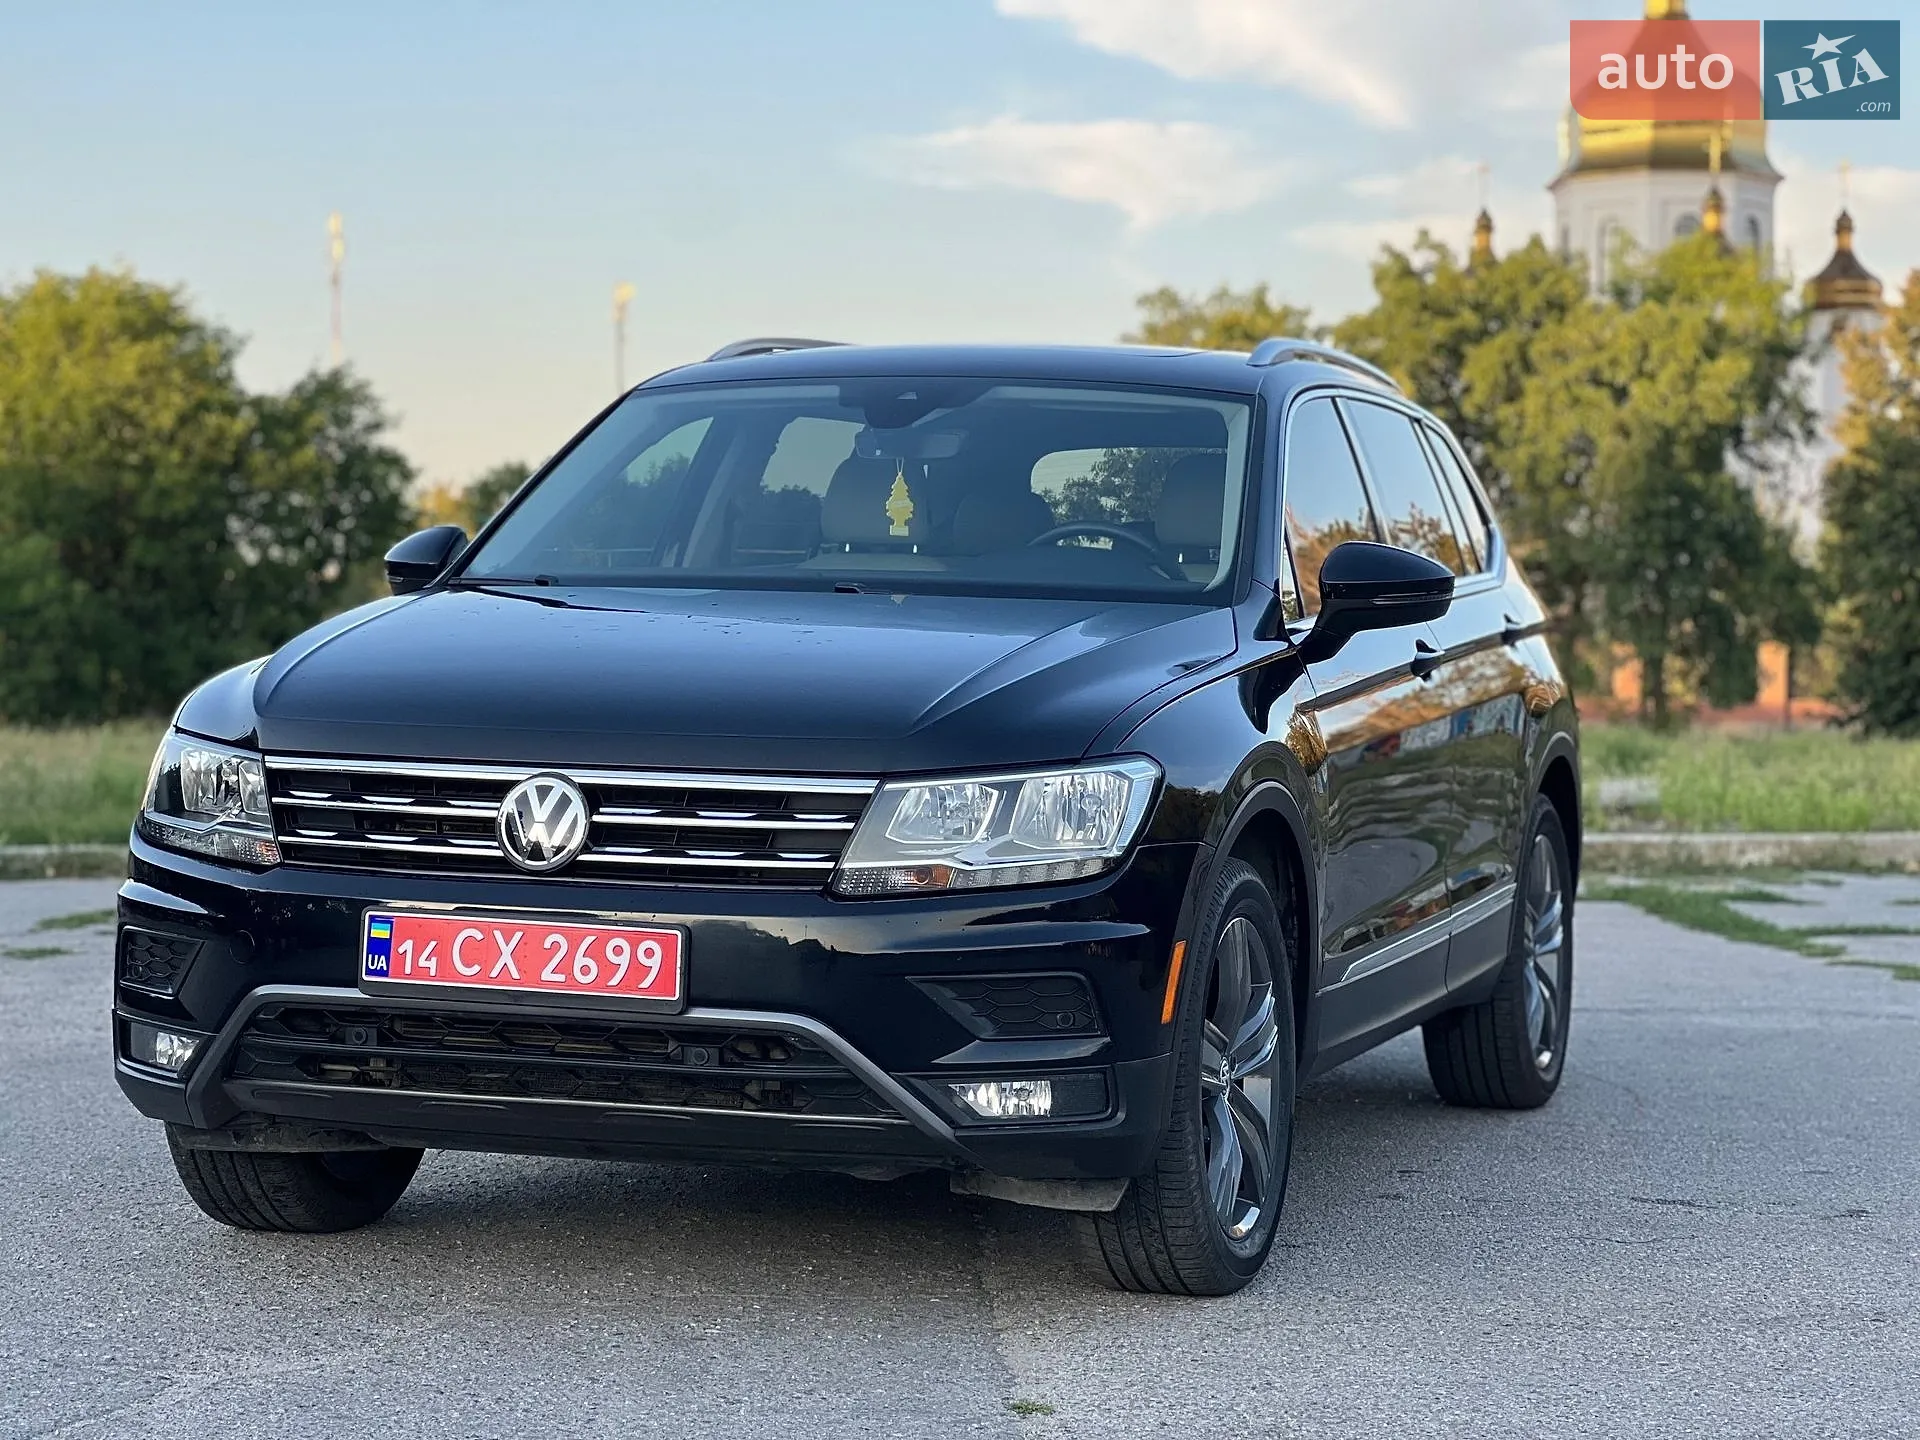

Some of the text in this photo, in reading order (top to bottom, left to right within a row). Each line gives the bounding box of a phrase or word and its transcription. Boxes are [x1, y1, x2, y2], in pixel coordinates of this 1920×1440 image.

[367, 953, 387, 971] UA
[397, 928, 663, 989] 14 CX 2699
